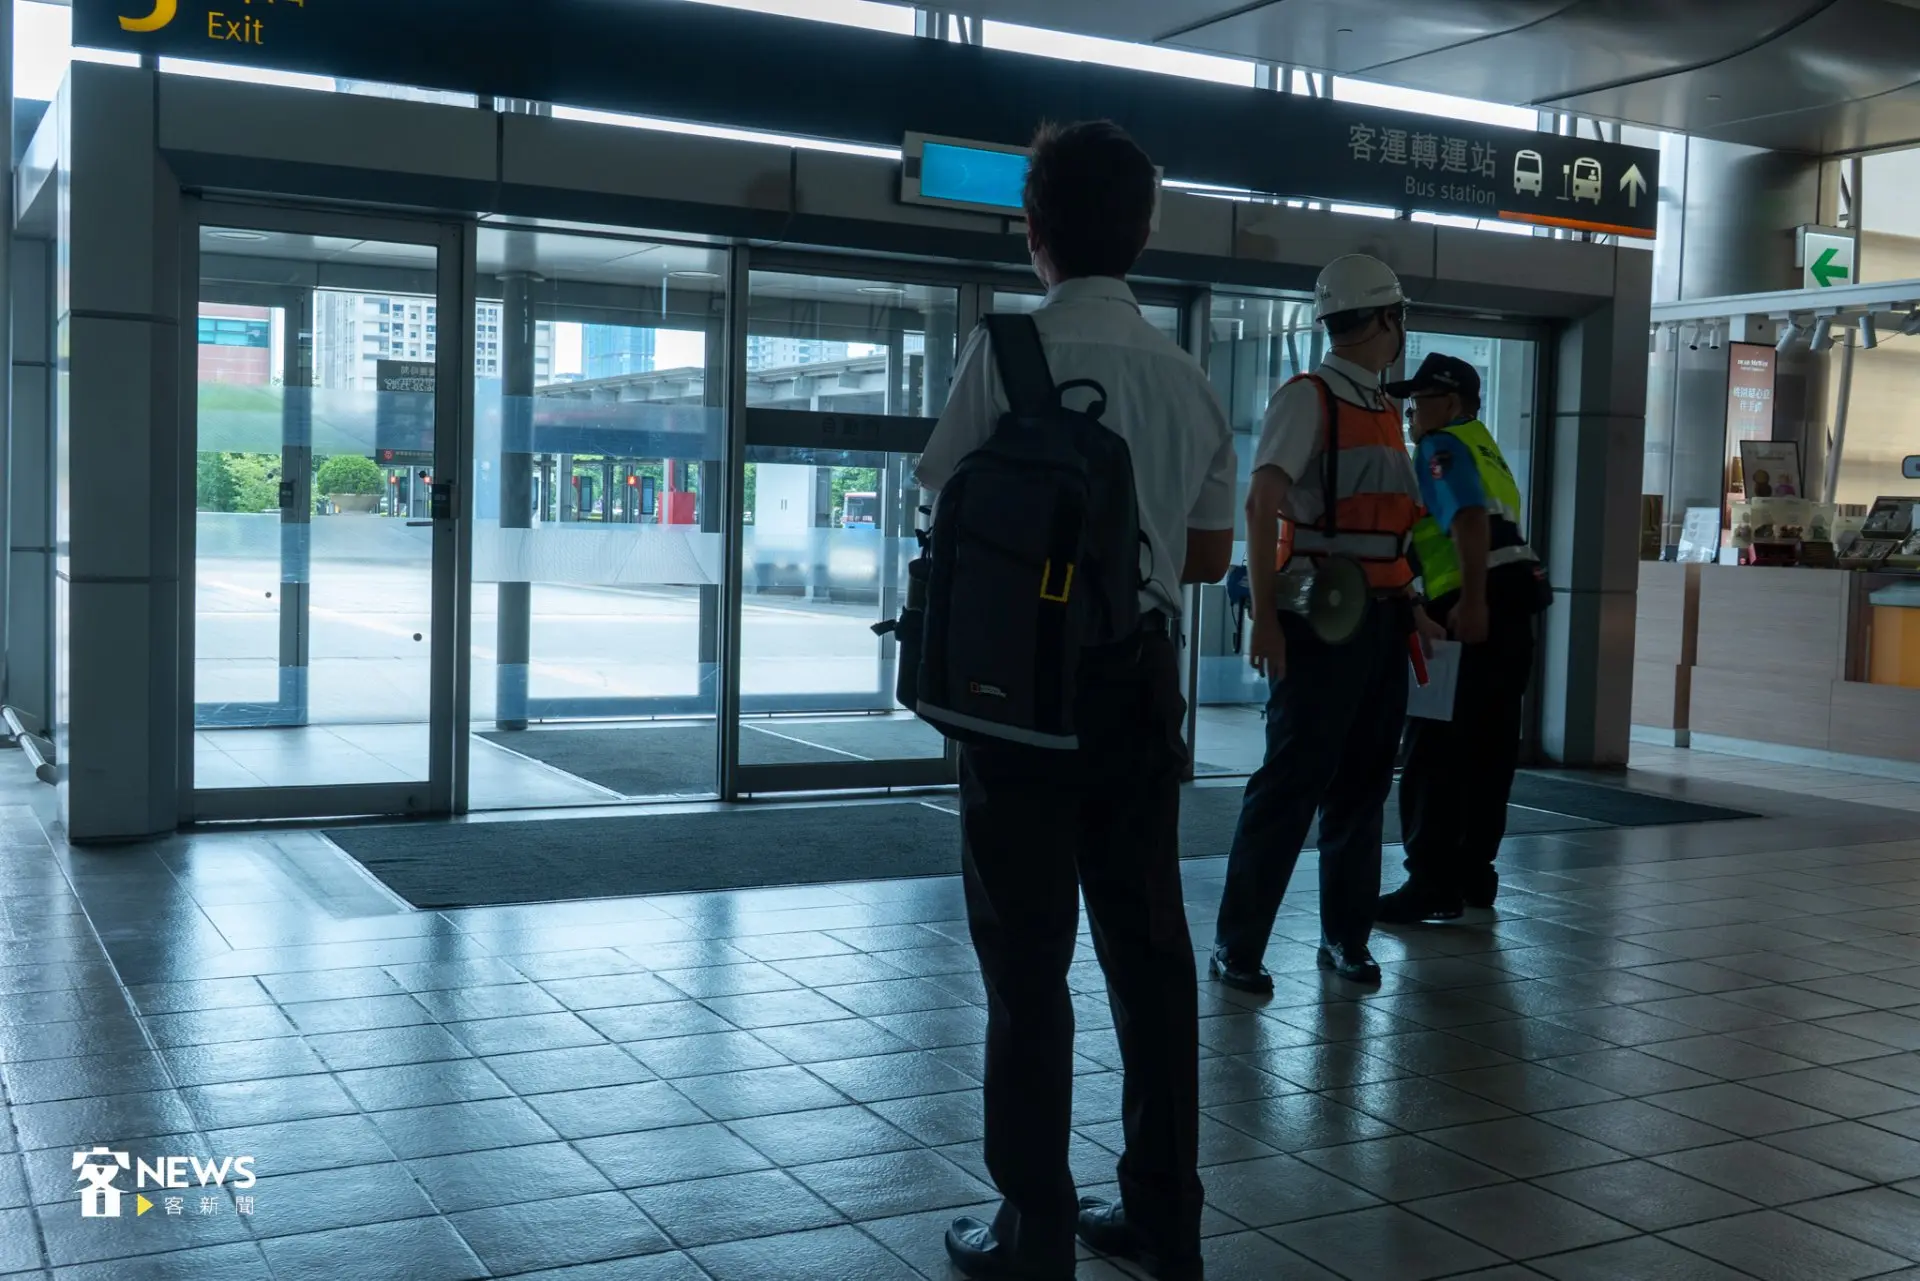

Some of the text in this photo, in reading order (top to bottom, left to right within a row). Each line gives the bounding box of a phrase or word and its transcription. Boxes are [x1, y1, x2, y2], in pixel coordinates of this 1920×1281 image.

[207, 11, 264, 44] Exit
[1348, 123, 1497, 178] 客運轉運站
[1405, 176, 1496, 205] Bus station
